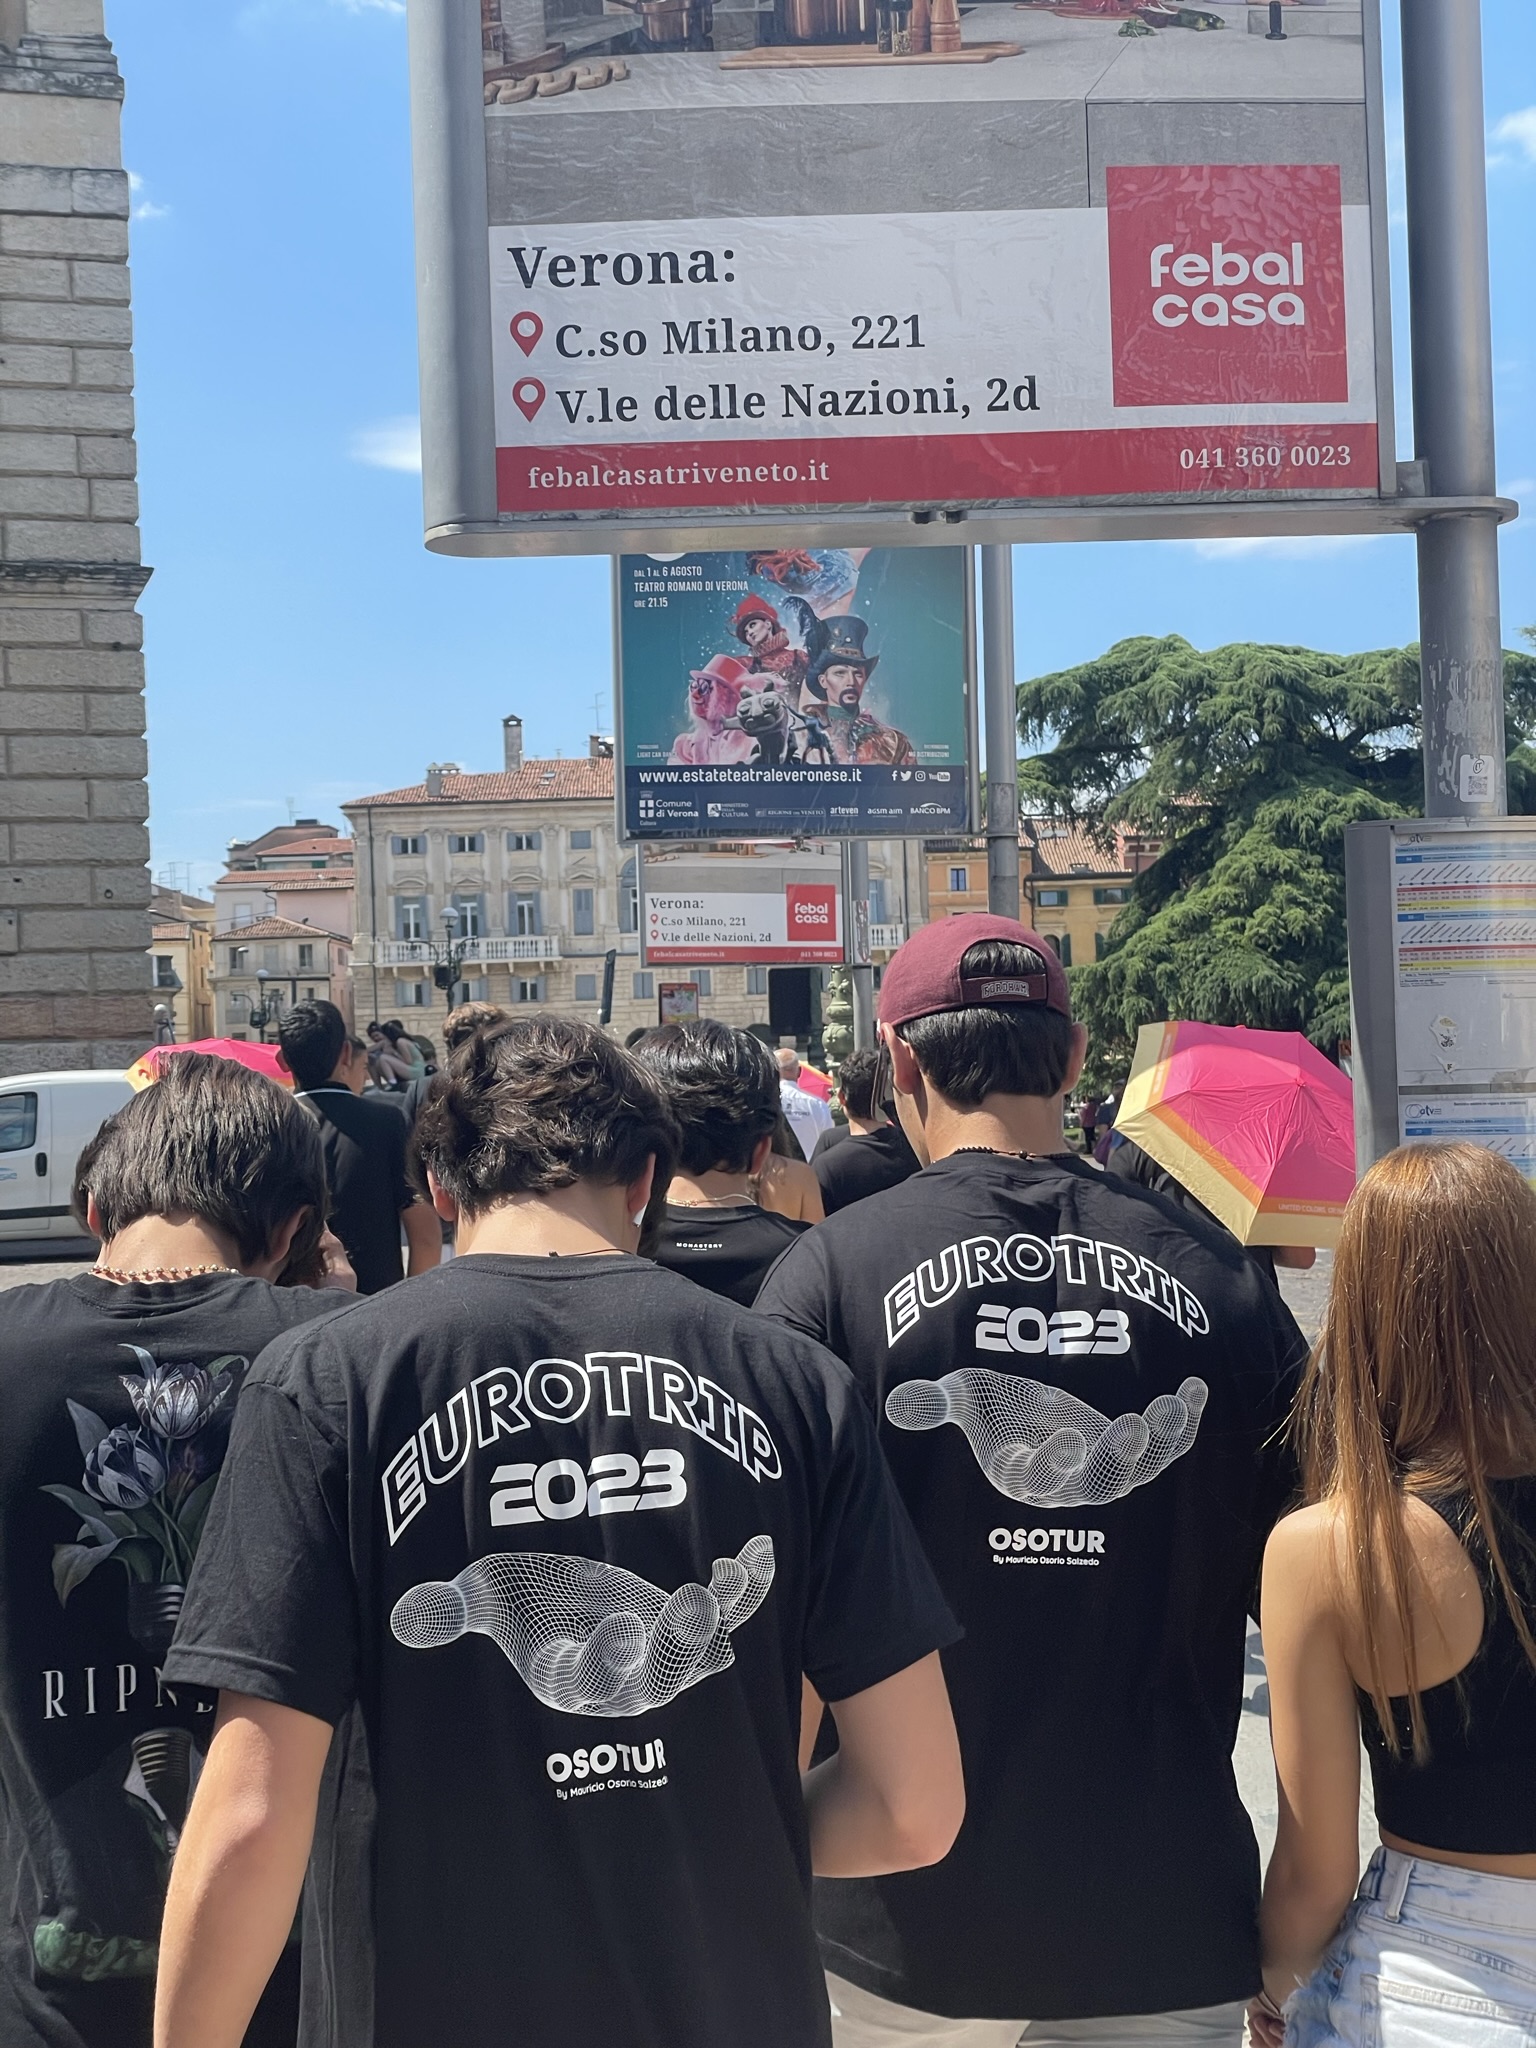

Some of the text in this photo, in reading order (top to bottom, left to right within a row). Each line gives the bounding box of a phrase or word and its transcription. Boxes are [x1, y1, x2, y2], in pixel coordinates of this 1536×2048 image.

[507, 246, 736, 289] Verona:
[1150, 242, 1304, 287] febal
[1152, 292, 1305, 328] casa
[555, 314, 926, 358] C.so Milano, 221
[555, 375, 1041, 423] V.le delle Nazioni, 2d
[1180, 446, 1351, 469] 041 360 0023
[528, 460, 829, 489] febalcasatriveneto.it
[633, 566, 703, 577] DAL 1 AL 6 AGOSTO
[634, 580, 749, 592] TEATRO ROMANO DI VERONA
[633, 597, 668, 608] ORE 21.15
[639, 768, 862, 783] www.estateteatraleveronese.it
[656, 800, 693, 808] Comune
[830, 806, 859, 815] arteven
[910, 807, 951, 815] BANCO BPM
[656, 809, 699, 818] di Verona
[650, 898, 704, 909] Verona:
[795, 902, 828, 914] febal
[660, 916, 747, 928] C.so Milano, 221
[795, 914, 829, 924] casa
[661, 932, 772, 943] V.le delle Nazioni, 2d
[883, 1233, 1210, 1349] EUROTRIP
[975, 1304, 1131, 1356] 2023
[381, 1351, 783, 1547] EUROTRIP
[489, 1448, 688, 1527] 2023
[988, 1527, 1106, 1554] OSOTUR
[992, 1554, 1100, 1566] By Mauricio Osorio Salzedo
[546, 1738, 667, 1783] OSOTUR
[556, 1788, 568, 1800] By
[570, 1781, 605, 1798] Mauricio
[607, 1779, 637, 1789] Osorio
